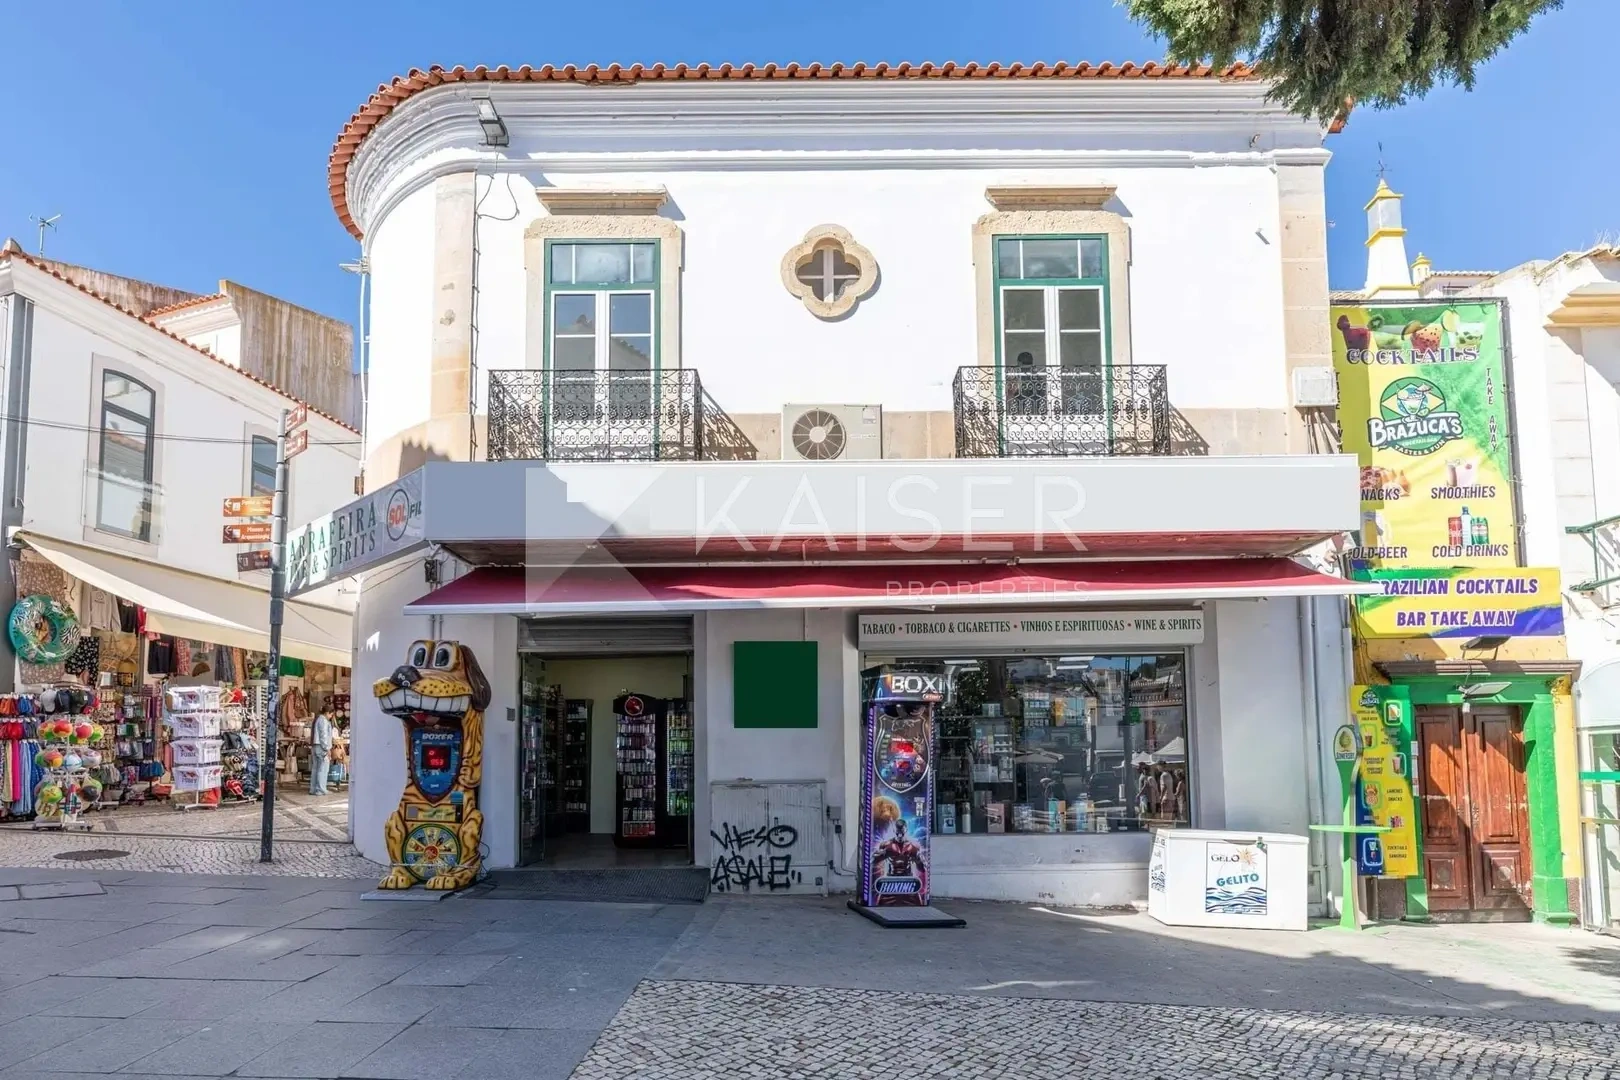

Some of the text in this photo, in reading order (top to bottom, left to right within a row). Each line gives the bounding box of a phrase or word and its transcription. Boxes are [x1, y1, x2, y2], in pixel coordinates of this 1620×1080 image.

[1346, 347, 1478, 365] COCKTAILS
[1369, 417, 1463, 446] BRAZUCA'S
[1361, 486, 1496, 501] NACKS SMOOTHIES
[389, 503, 406, 528] SOL
[289, 501, 376, 562] ARRAFEIRA
[312, 555, 319, 575] &
[323, 530, 376, 571] SPIRITS
[1378, 546, 1408, 559] BEER
[1432, 544, 1509, 558] COLD DRINKS
[1372, 578, 1538, 595] RAZILIAN COCKTAILS
[862, 618, 1202, 635] TABACO TOBBACO & CIGARETTES VINHOS E ESPIRITUOSAS WINE & SPIRITS
[1397, 611, 1516, 626] BAR TAKE AWAY
[1211, 853, 1240, 863] GELO
[880, 882, 916, 893] BOXING
[1216, 873, 1259, 887] GELITO
